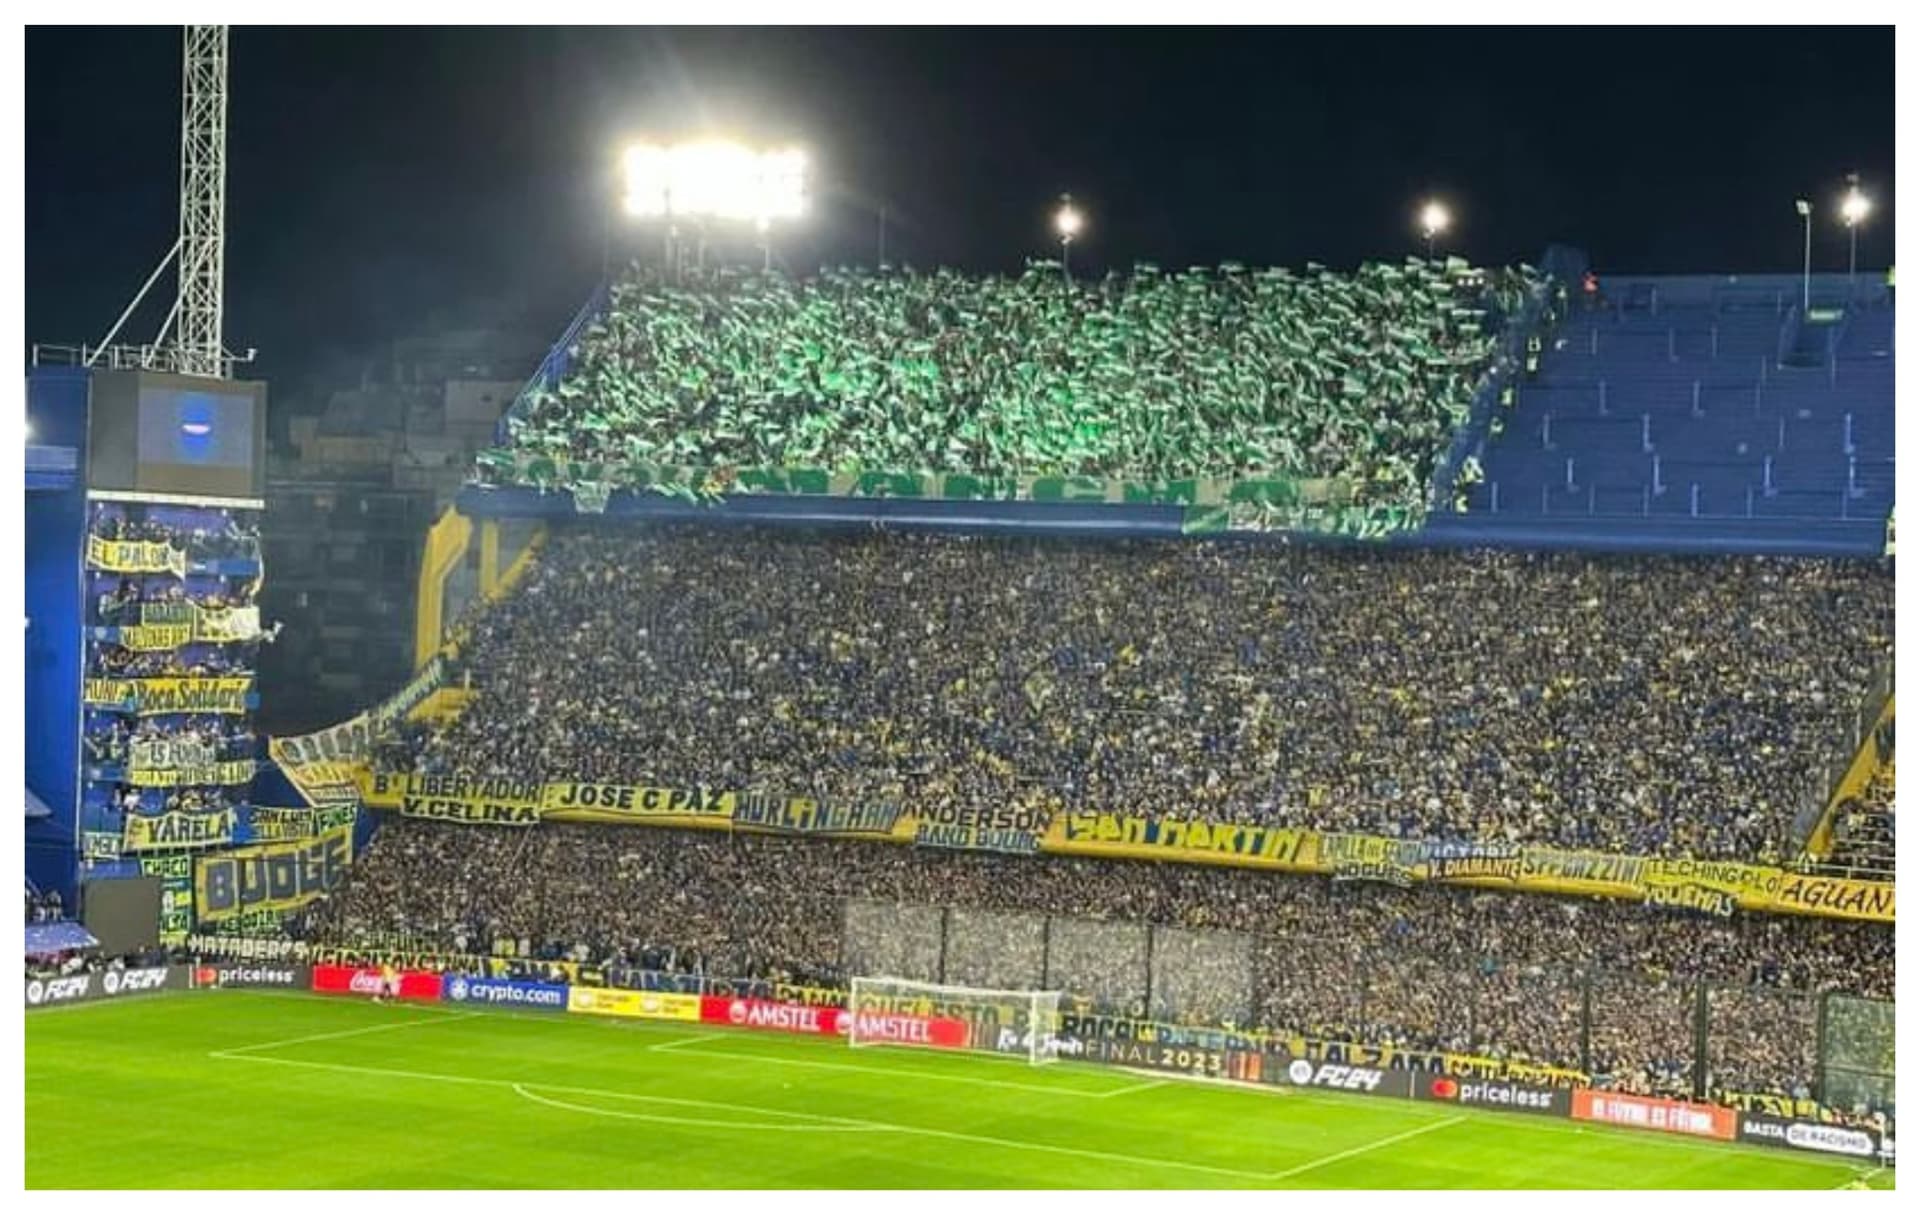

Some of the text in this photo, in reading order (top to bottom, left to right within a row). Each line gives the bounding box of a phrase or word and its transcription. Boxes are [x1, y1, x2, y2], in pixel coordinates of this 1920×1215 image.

[406, 775, 541, 802] LIBERTADOR
[560, 784, 723, 811] JOSE C PAZ
[403, 797, 537, 822] V.CELINA
[148, 812, 231, 844] VARELA
[1782, 877, 1893, 914] AGUAN
[219, 965, 295, 984] priceless
[471, 982, 561, 1003] crypto.com
[748, 1005, 821, 1030] AMSTEL
[856, 1015, 931, 1042] AMSTEL
[1086, 1041, 1156, 1064] FINAL
[1162, 1048, 1222, 1071] 2023
[1460, 1081, 1552, 1107] priceless
[1744, 1121, 1785, 1139] BASTA
